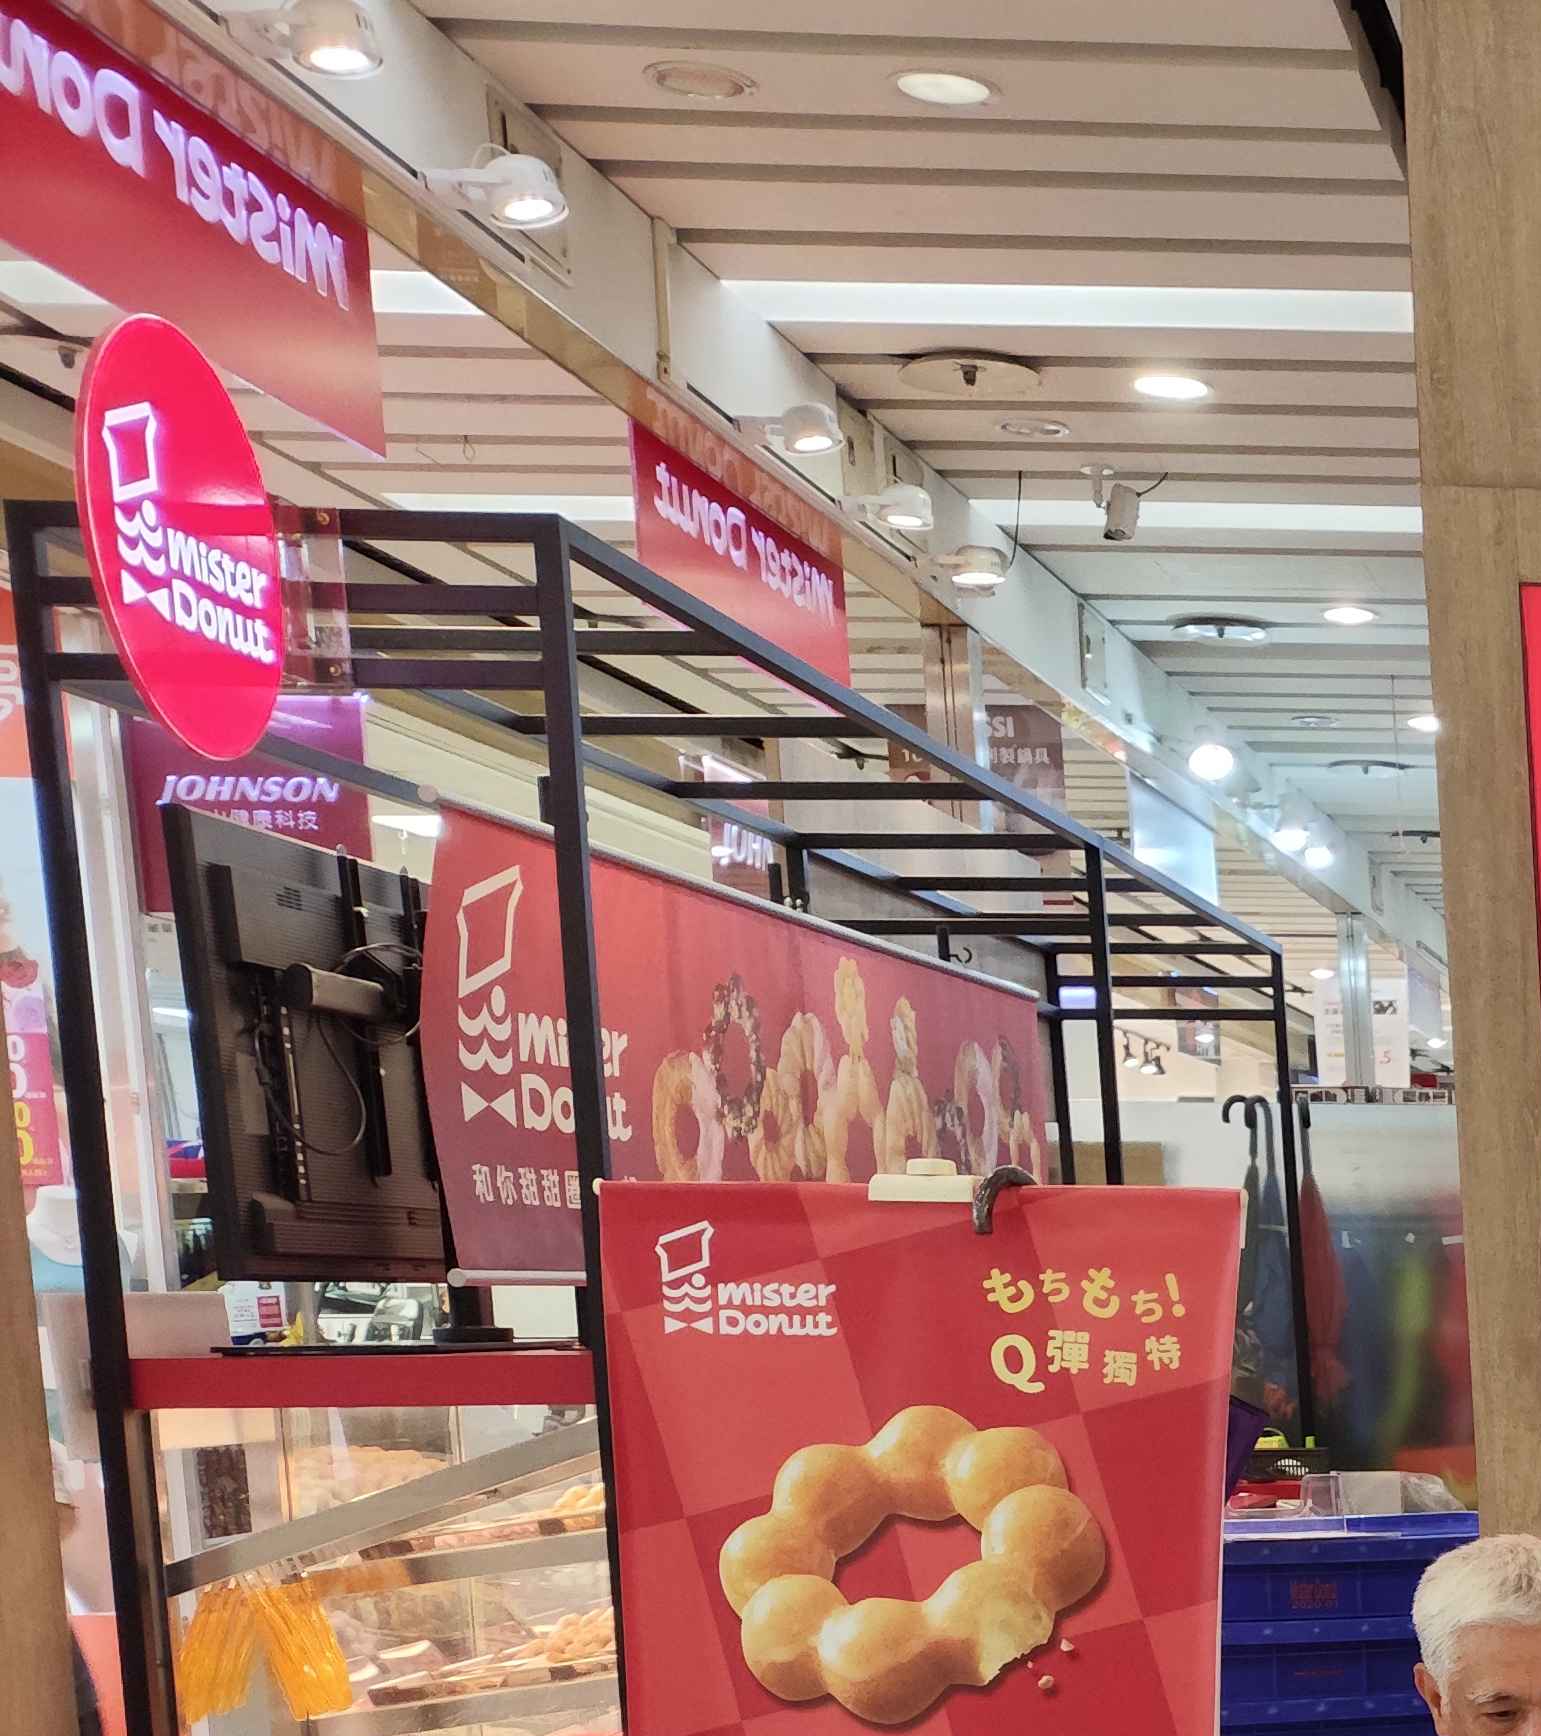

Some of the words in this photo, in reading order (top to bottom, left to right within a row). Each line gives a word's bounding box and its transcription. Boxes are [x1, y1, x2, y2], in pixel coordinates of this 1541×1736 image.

[172, 577, 277, 665] Donut
[155, 774, 341, 806] JOHNSON
[718, 1309, 838, 1337] Donut
